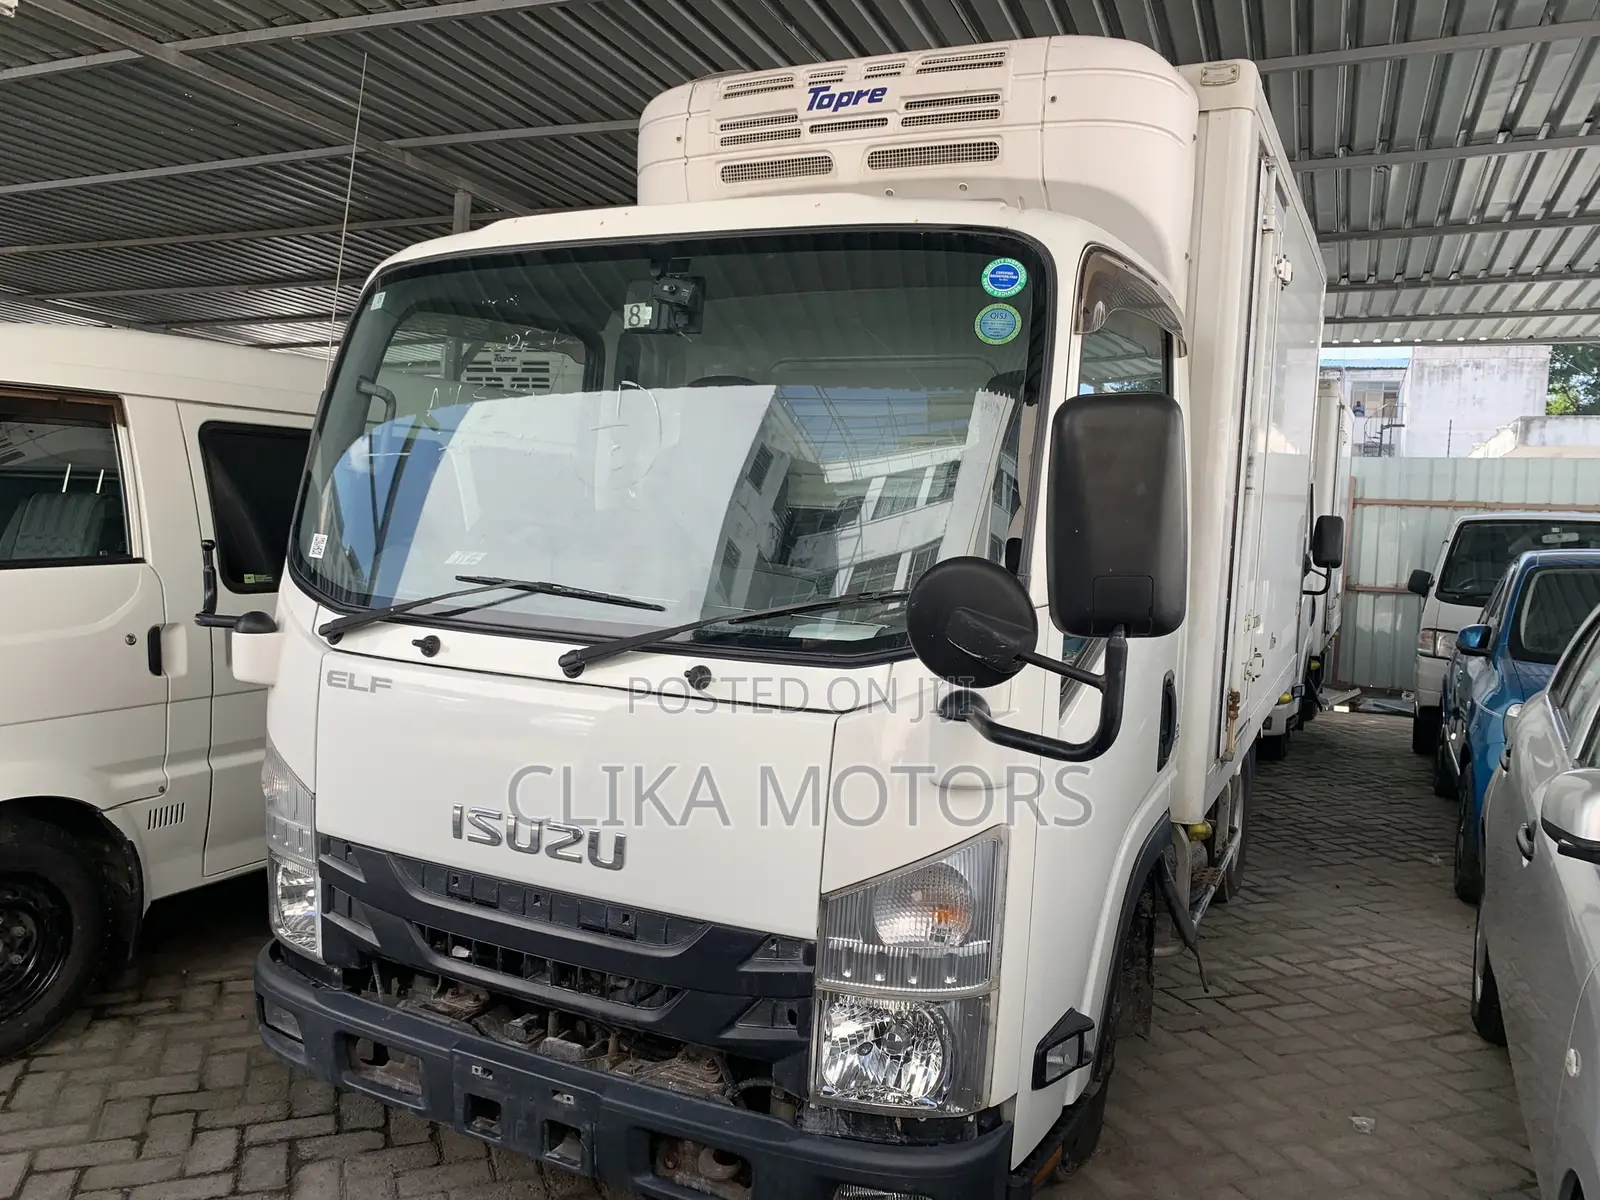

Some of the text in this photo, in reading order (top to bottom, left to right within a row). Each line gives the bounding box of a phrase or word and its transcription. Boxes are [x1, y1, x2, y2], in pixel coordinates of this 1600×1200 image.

[807, 85, 888, 112] Topre
[628, 304, 640, 327] 8
[493, 354, 517, 363] Topre
[327, 670, 393, 693] ELF
[452, 803, 627, 871] ISUZU
